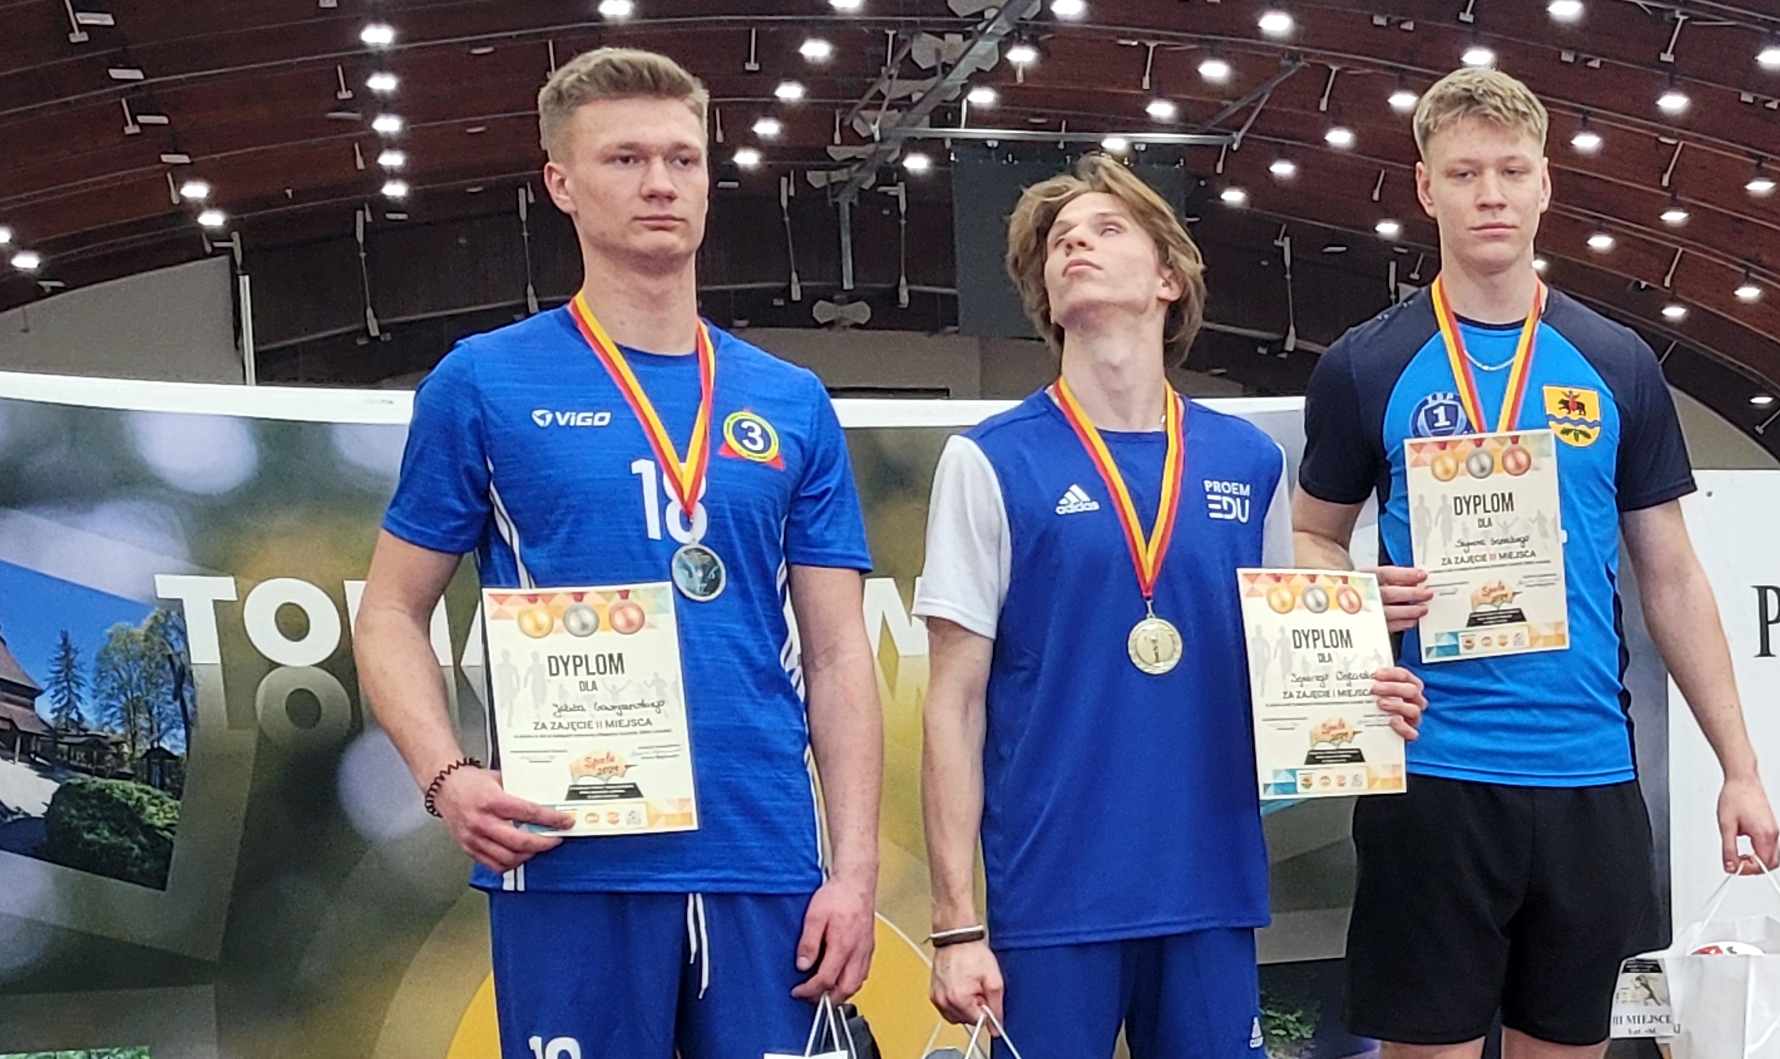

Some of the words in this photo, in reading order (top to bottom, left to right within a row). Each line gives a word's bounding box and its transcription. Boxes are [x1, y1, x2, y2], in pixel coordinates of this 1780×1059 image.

[1432, 405, 1451, 427] 1
[739, 419, 765, 452] 3
[1203, 479, 1250, 497] PROEM
[631, 459, 708, 545] 18
[1206, 495, 1250, 523] EDU
[1453, 491, 1515, 516] DYPLOM
[1477, 517, 1493, 529] DLA
[1441, 557, 1453, 566] ZA
[1498, 549, 1537, 561] MIEJSCA
[1291, 628, 1354, 650] DYPLOM
[547, 652, 625, 677] DYPLOM
[1317, 652, 1333, 664] DLA
[579, 680, 598, 692] DLA
[533, 721, 547, 730] ZA
[605, 717, 653, 728] MIEJSCA
